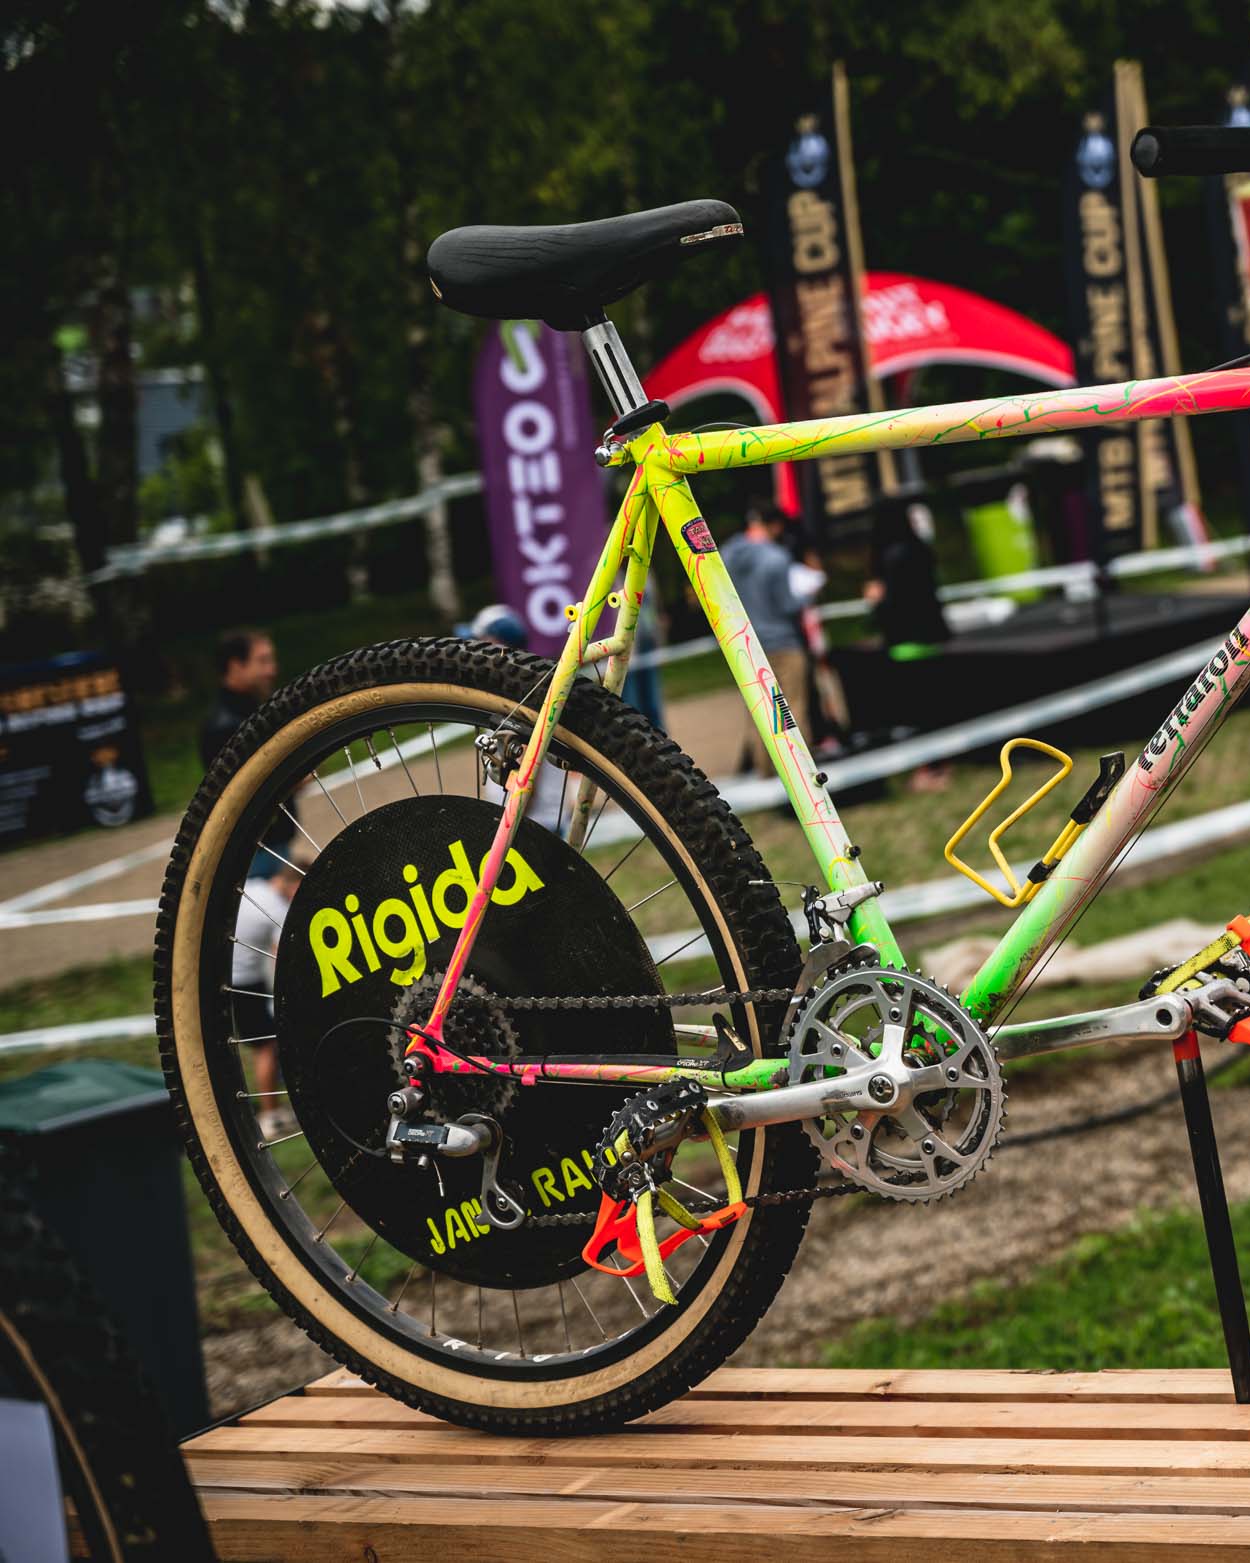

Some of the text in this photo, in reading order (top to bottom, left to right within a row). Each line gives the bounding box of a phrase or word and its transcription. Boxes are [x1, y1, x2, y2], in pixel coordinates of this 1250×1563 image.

[1079, 190, 1123, 277] CUP
[503, 401, 576, 637] OKTEO
[309, 840, 545, 998] Rigida
